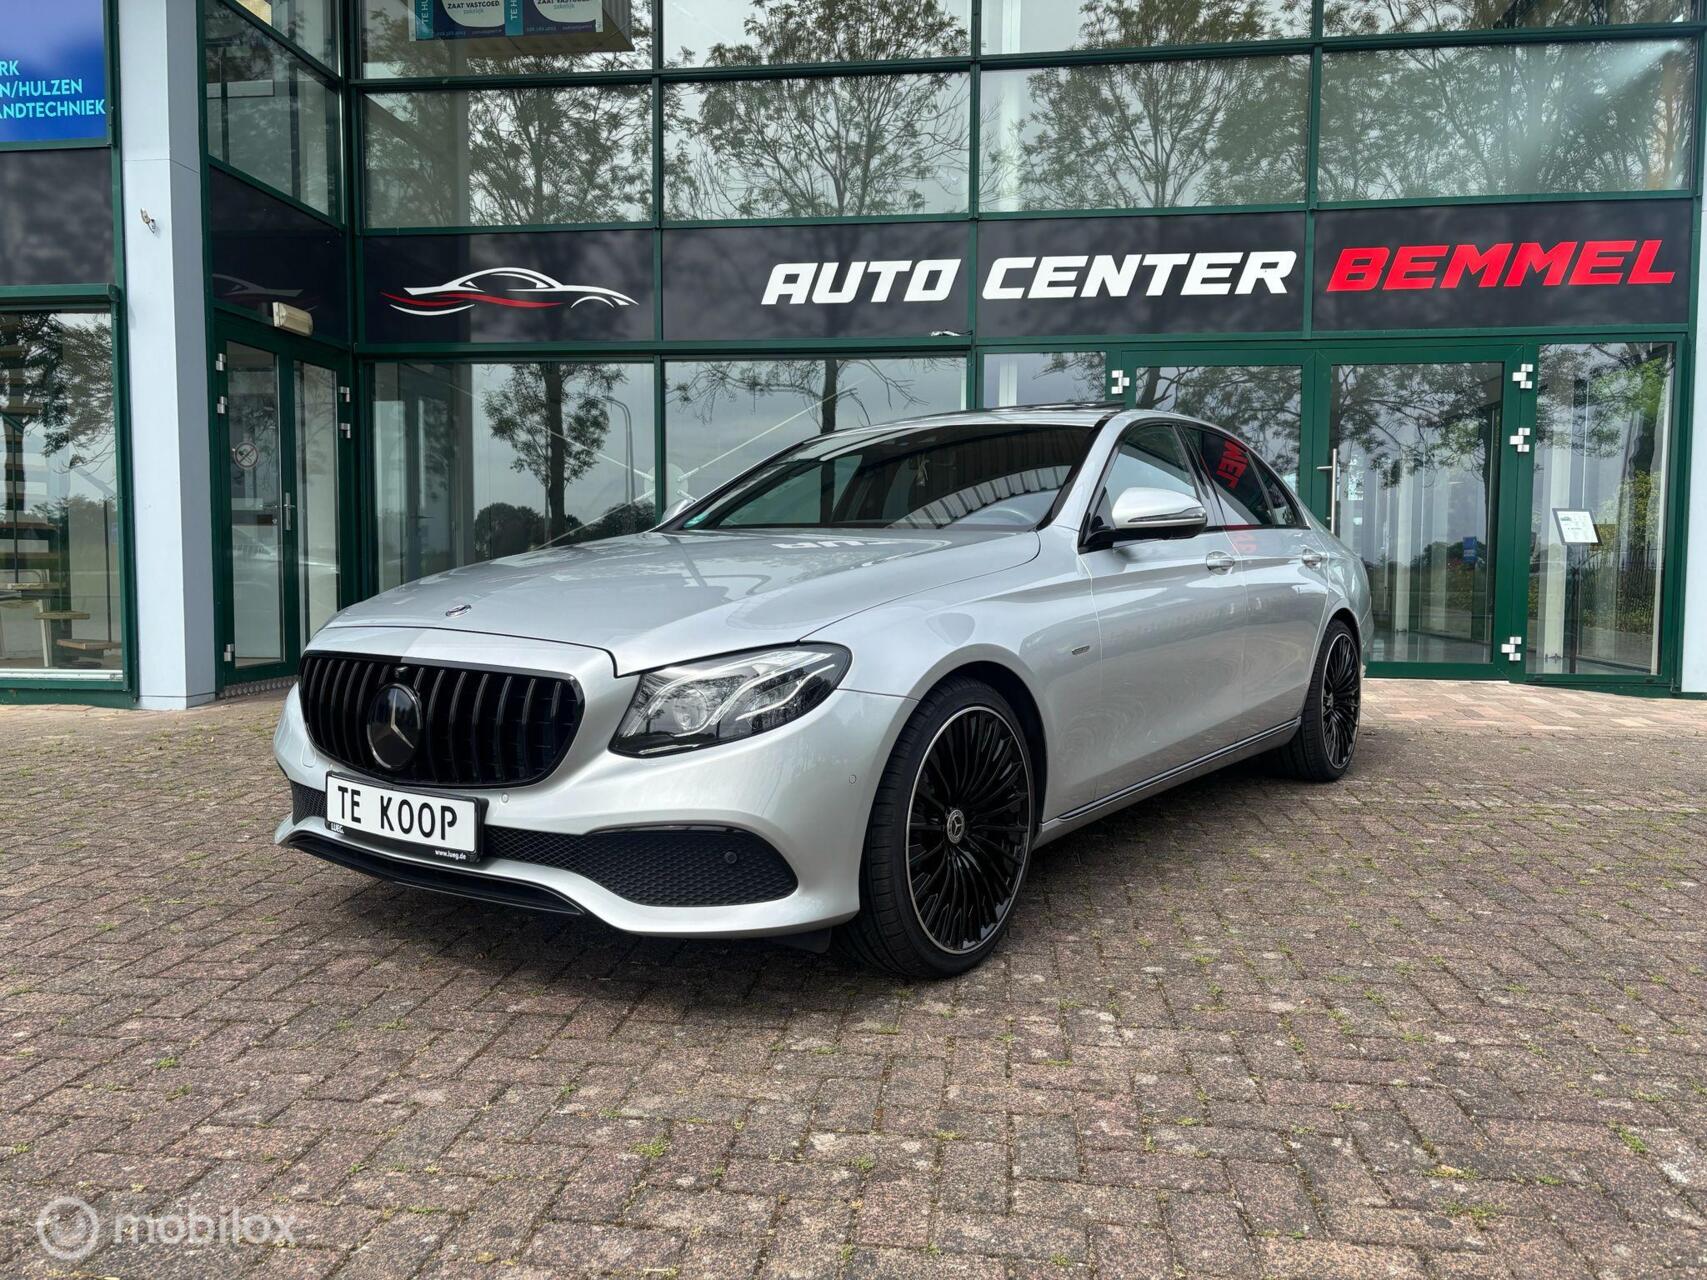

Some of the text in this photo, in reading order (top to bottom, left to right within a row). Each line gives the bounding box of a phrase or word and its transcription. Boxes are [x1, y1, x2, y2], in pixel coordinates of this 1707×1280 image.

[0, 99, 106, 119] NDTECHNIEK
[761, 240, 1676, 305] AUTO CENTER BEMMEL
[337, 785, 458, 841] TE KOOP
